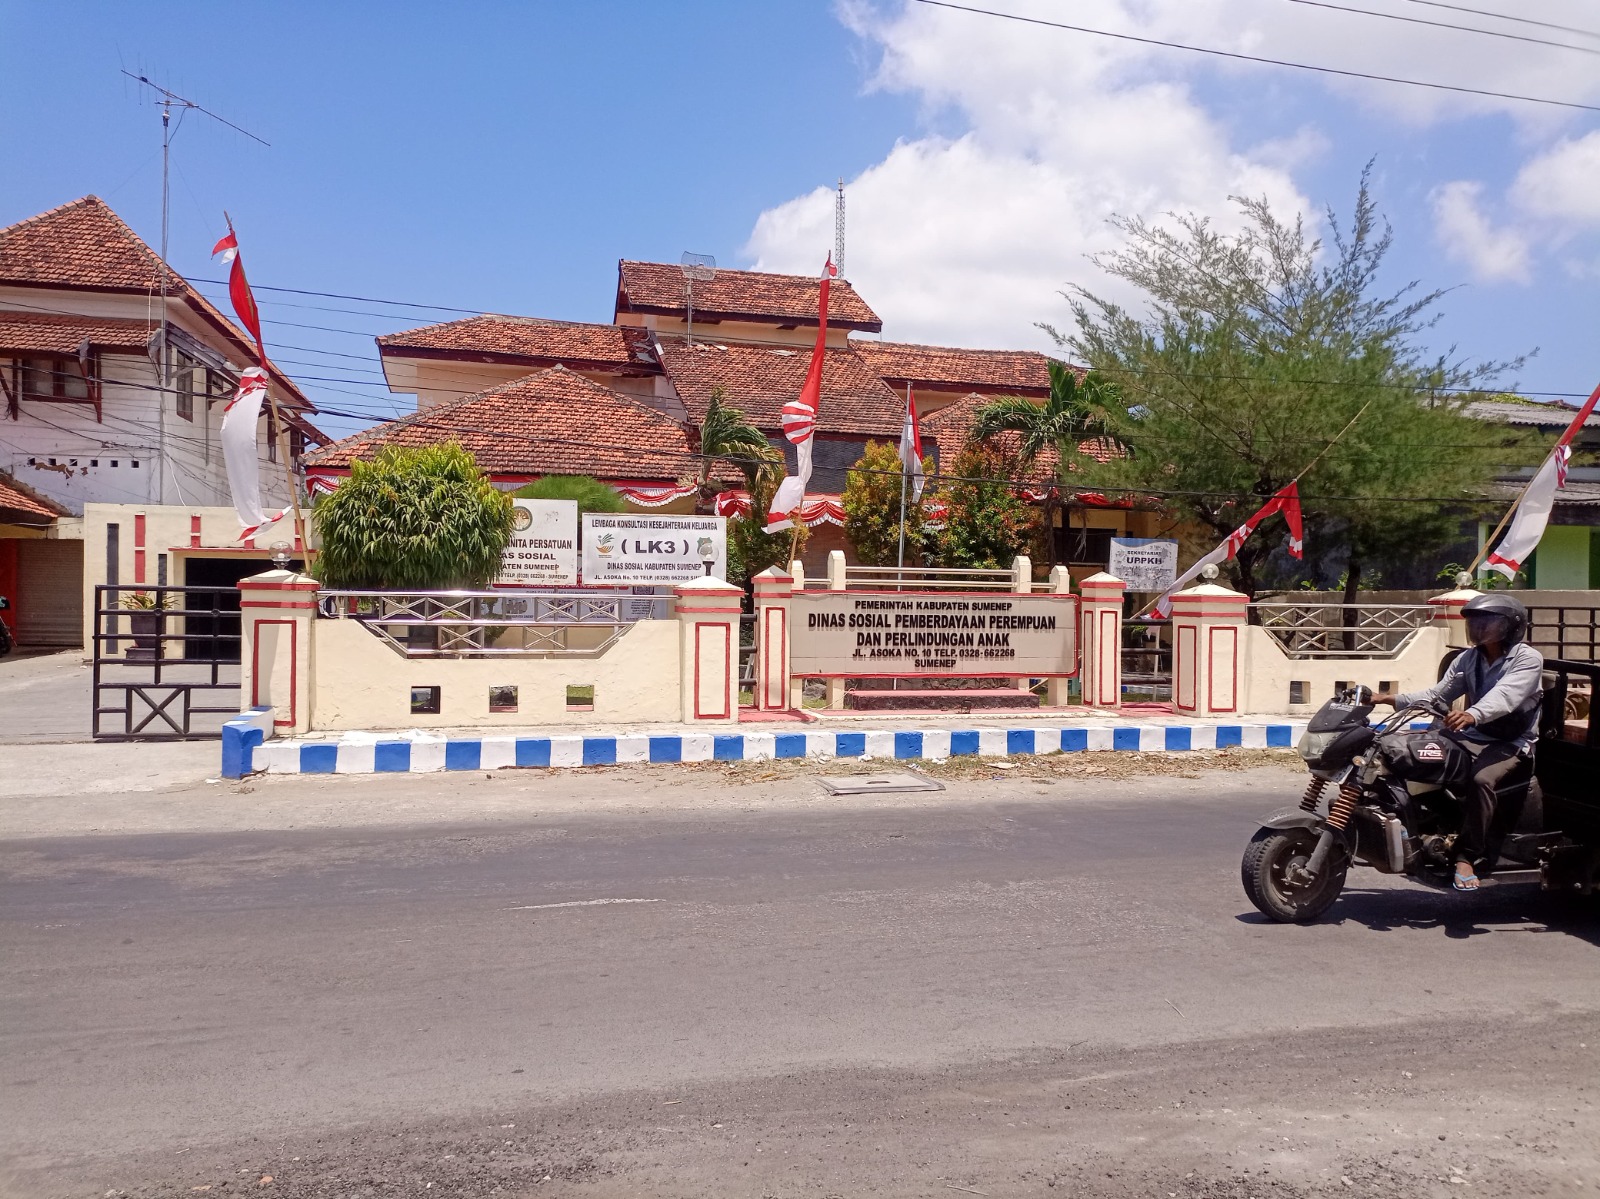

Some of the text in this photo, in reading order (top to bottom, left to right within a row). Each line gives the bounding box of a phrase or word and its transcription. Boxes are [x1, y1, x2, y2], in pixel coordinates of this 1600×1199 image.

[592, 519, 718, 531] LEMBAGA KONSULTASI KESEJAHTERAAN KELUARGA
[529, 539, 572, 550] PERSATUAN
[635, 540, 676, 554] LK3
[607, 562, 624, 570] DINAS
[624, 562, 644, 570] SOSIAL
[644, 562, 676, 570] KABUPATEN
[855, 600, 1012, 611] PEMERINTAH KABUPATEN SUMENEP
[808, 613, 1056, 630] DINAS SOSIAL PEMBERDAYAAN PEREMPUAN
[857, 632, 1010, 646] DAN PERLINDUNGAN ANAK
[870, 648, 902, 657] ASOKA
[904, 648, 920, 657] NO.
[922, 648, 932, 657] 10
[934, 648, 958, 657] TELP.
[960, 648, 1014, 658] 0328-662268
[914, 659, 956, 668] SUMENEP
